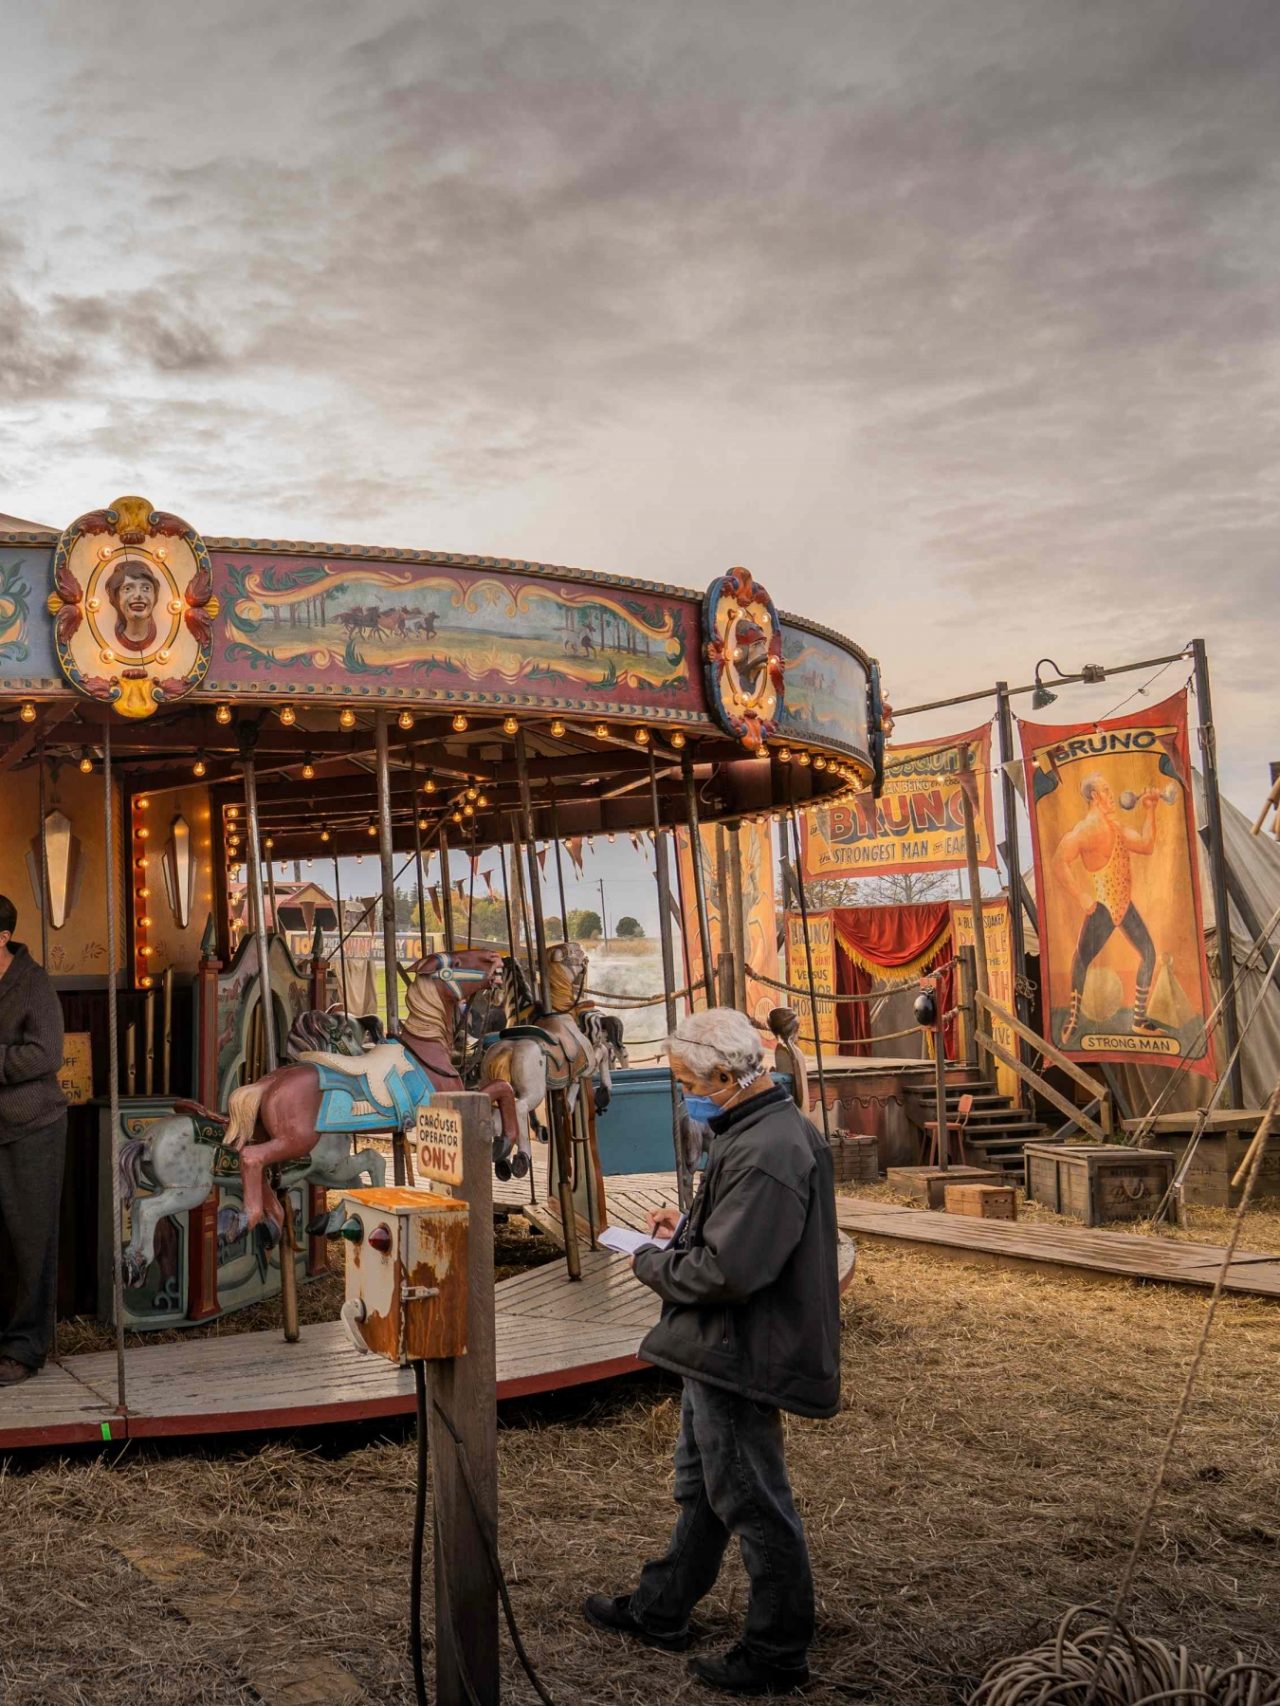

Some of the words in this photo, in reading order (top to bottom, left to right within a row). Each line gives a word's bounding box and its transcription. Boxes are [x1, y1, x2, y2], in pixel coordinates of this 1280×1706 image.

[1054, 731, 1156, 762] BRUNO
[832, 842, 897, 864] STRONGEST
[902, 839, 928, 859] MAN
[796, 969, 827, 980] VESUS
[1088, 1036, 1136, 1048] STRONG
[1140, 1040, 1170, 1051] MAN
[420, 1114, 458, 1134] CAROUSEL
[420, 1130, 458, 1147] OPERATOR
[421, 1145, 457, 1174] ONLY
